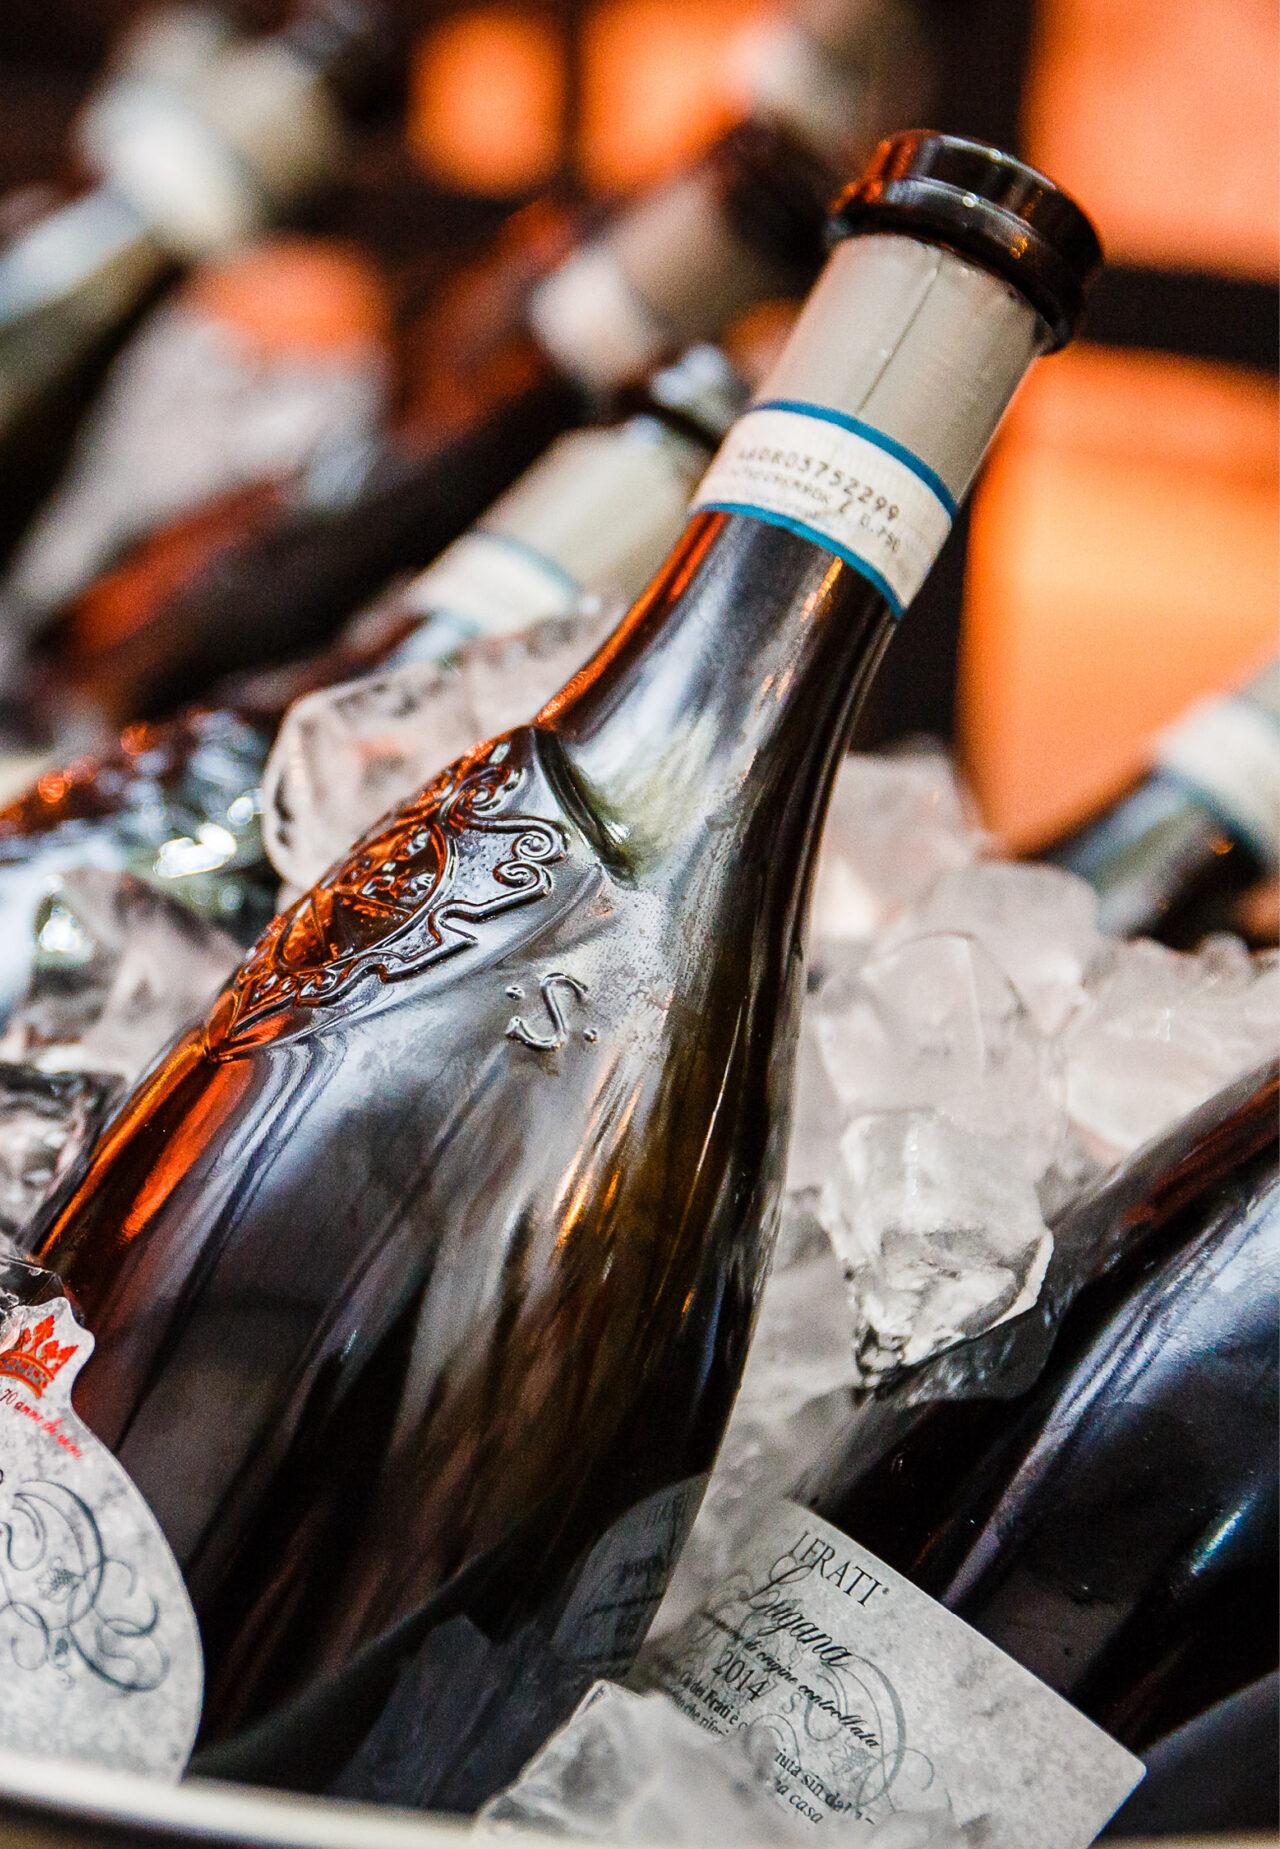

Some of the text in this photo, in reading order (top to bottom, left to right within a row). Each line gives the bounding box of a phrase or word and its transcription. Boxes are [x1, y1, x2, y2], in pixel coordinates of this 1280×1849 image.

[0, 1388, 18, 1405] 70
[13, 1401, 45, 1424] anni
[749, 1554, 852, 1667] Lugana
[712, 1650, 770, 1702] 2014
[757, 1652, 798, 1684] origine
[798, 1685, 880, 1749] controllata
[703, 1689, 734, 1719] Frati
[774, 1748, 802, 1777] iuta
[801, 1774, 825, 1797] sin
[789, 1794, 824, 1825] casa
